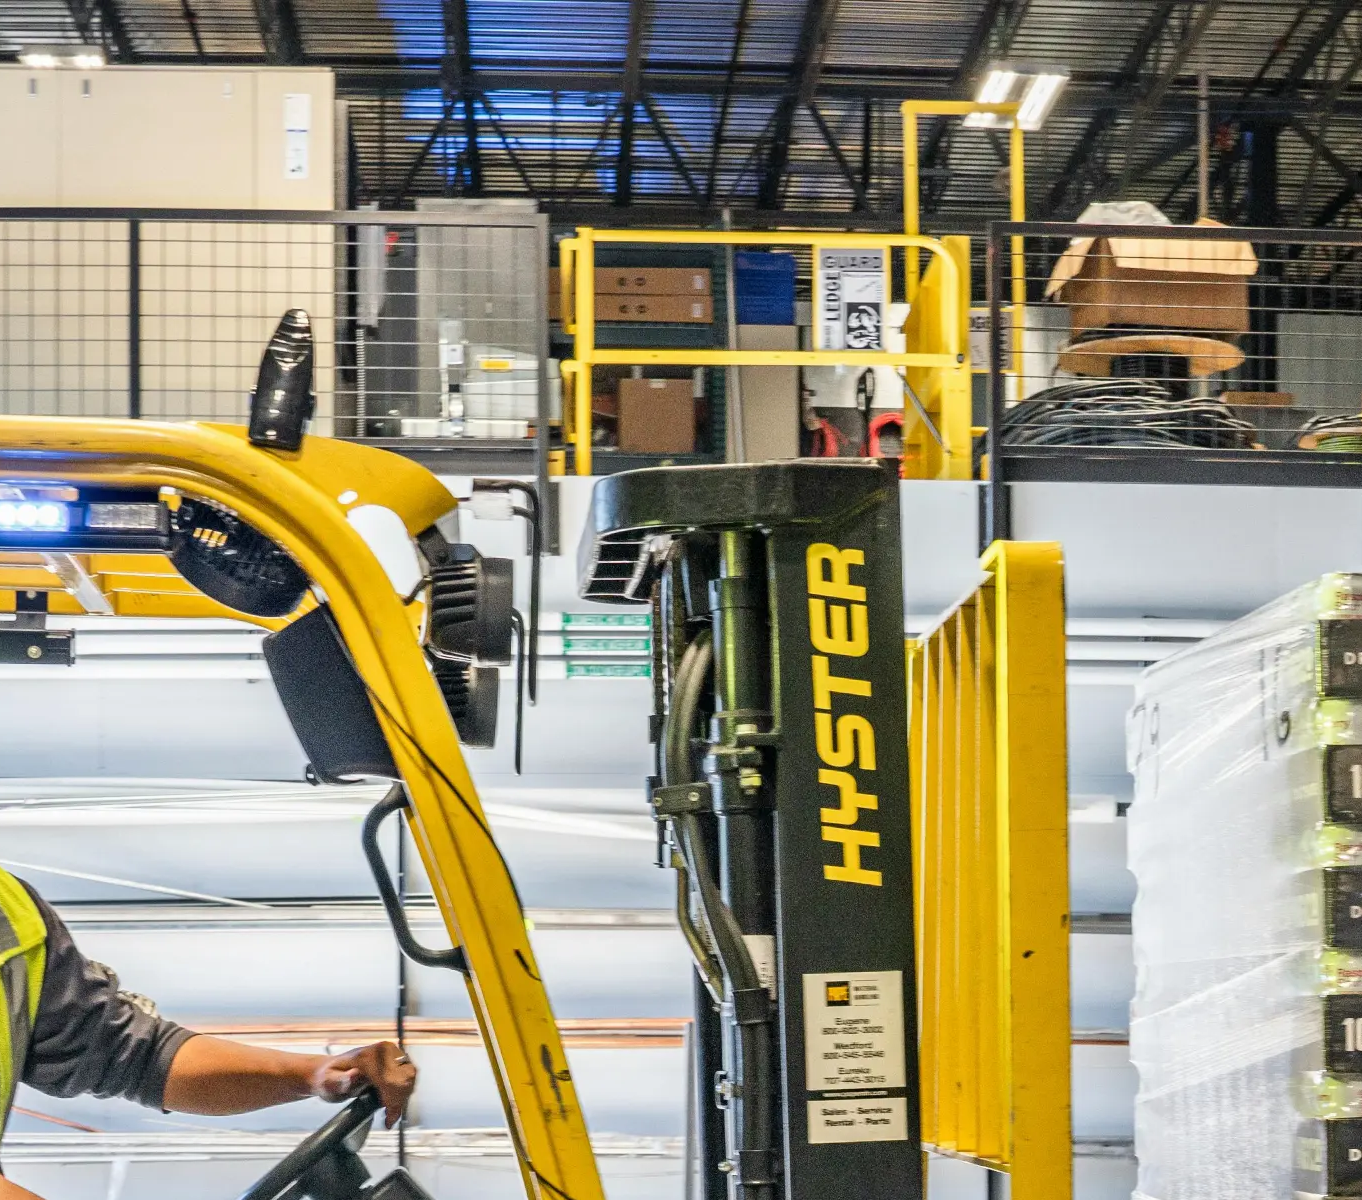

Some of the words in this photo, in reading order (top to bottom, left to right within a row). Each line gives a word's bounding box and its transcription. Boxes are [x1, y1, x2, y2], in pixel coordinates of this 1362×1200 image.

[806, 543, 883, 886] HYSTER
[822, 1107, 847, 1116] Sales
[857, 1106, 892, 1115] Service
[865, 1118, 890, 1126] Parts
